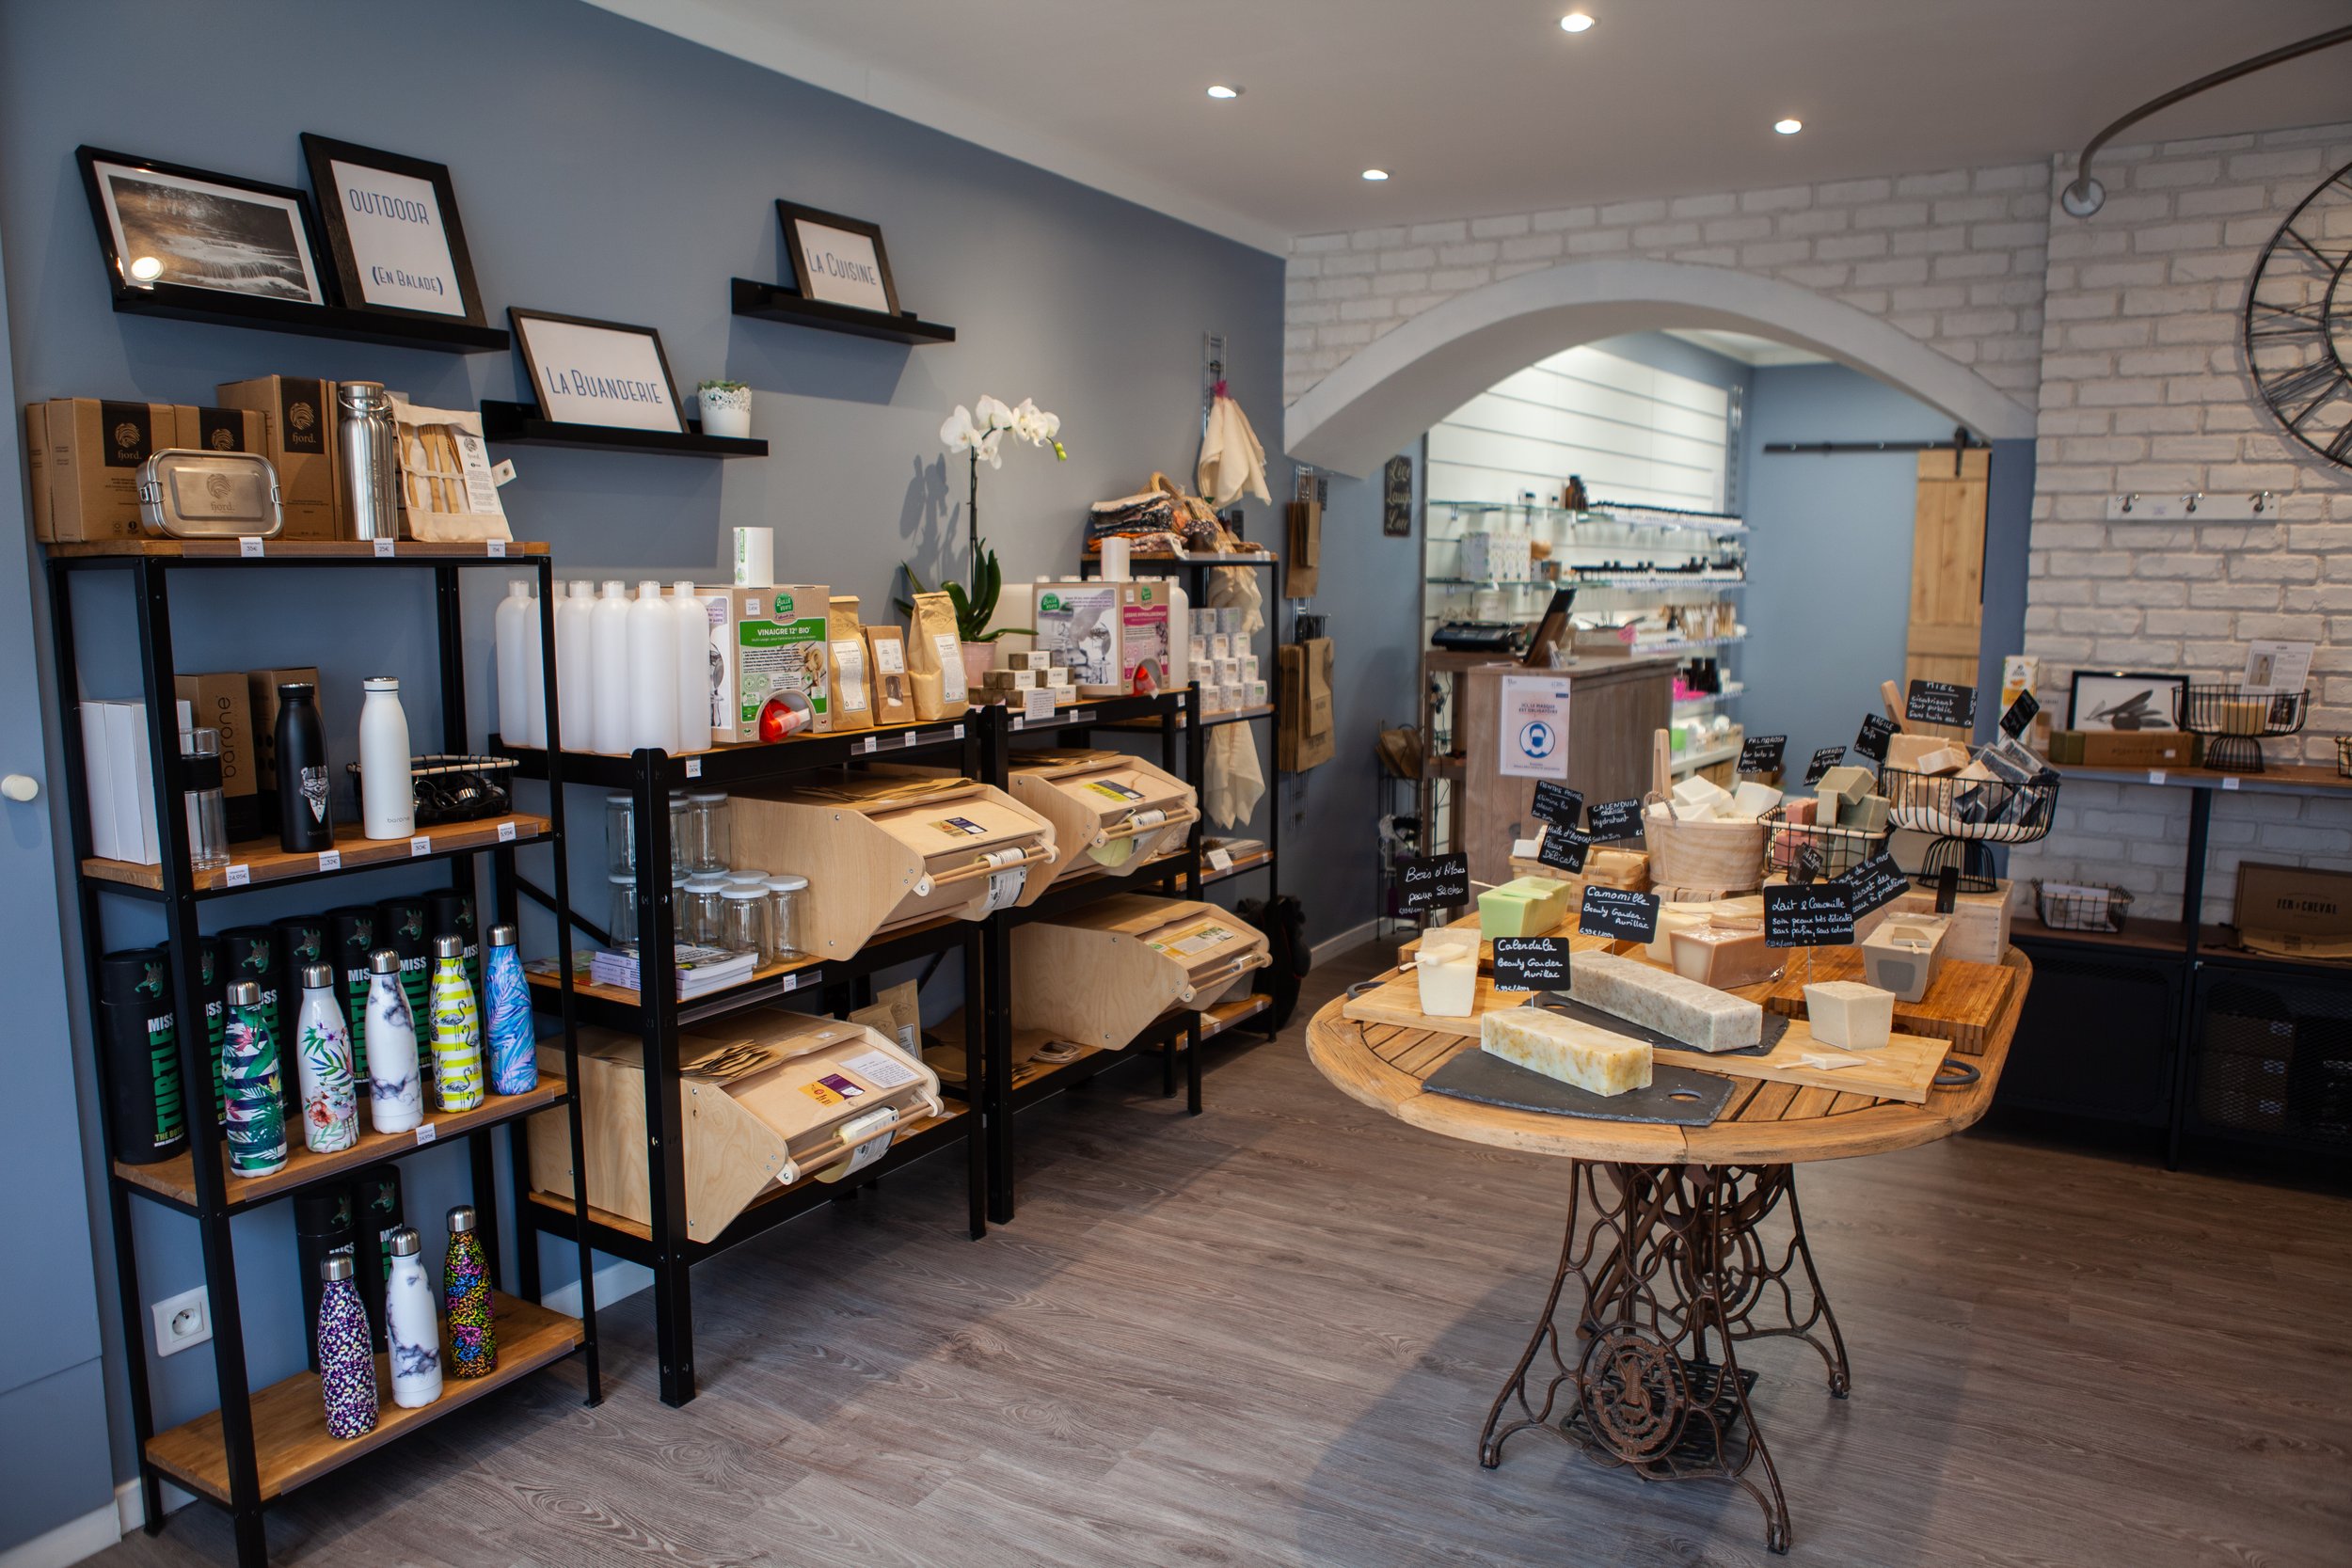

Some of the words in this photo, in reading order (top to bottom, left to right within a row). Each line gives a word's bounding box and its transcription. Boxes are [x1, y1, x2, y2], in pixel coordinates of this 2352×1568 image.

[349, 188, 430, 226] OUTDOOR
[217, 697, 236, 779] barone
[1593, 800, 1638, 812] CALENDULA
[1593, 815, 1629, 828] Hydratant
[1406, 866, 1431, 882] Bois
[1586, 886, 1650, 906] Camomille
[1583, 902, 1609, 918] Beauty
[1772, 897, 1797, 911] Lait
[2302, 901, 2337, 914] CHEVAL
[1615, 917, 1649, 929] Aurillac
[1498, 938, 1558, 952] Calendula
[1497, 957, 1525, 971] Beauty
[1527, 958, 1563, 967] Garden
[348, 968, 371, 982] MIS
[1523, 970, 1561, 978] Aurillac
[148, 1012, 173, 1033] MISS
[150, 1028, 183, 1133] TURTLE
[155, 1132, 168, 1142] THE
